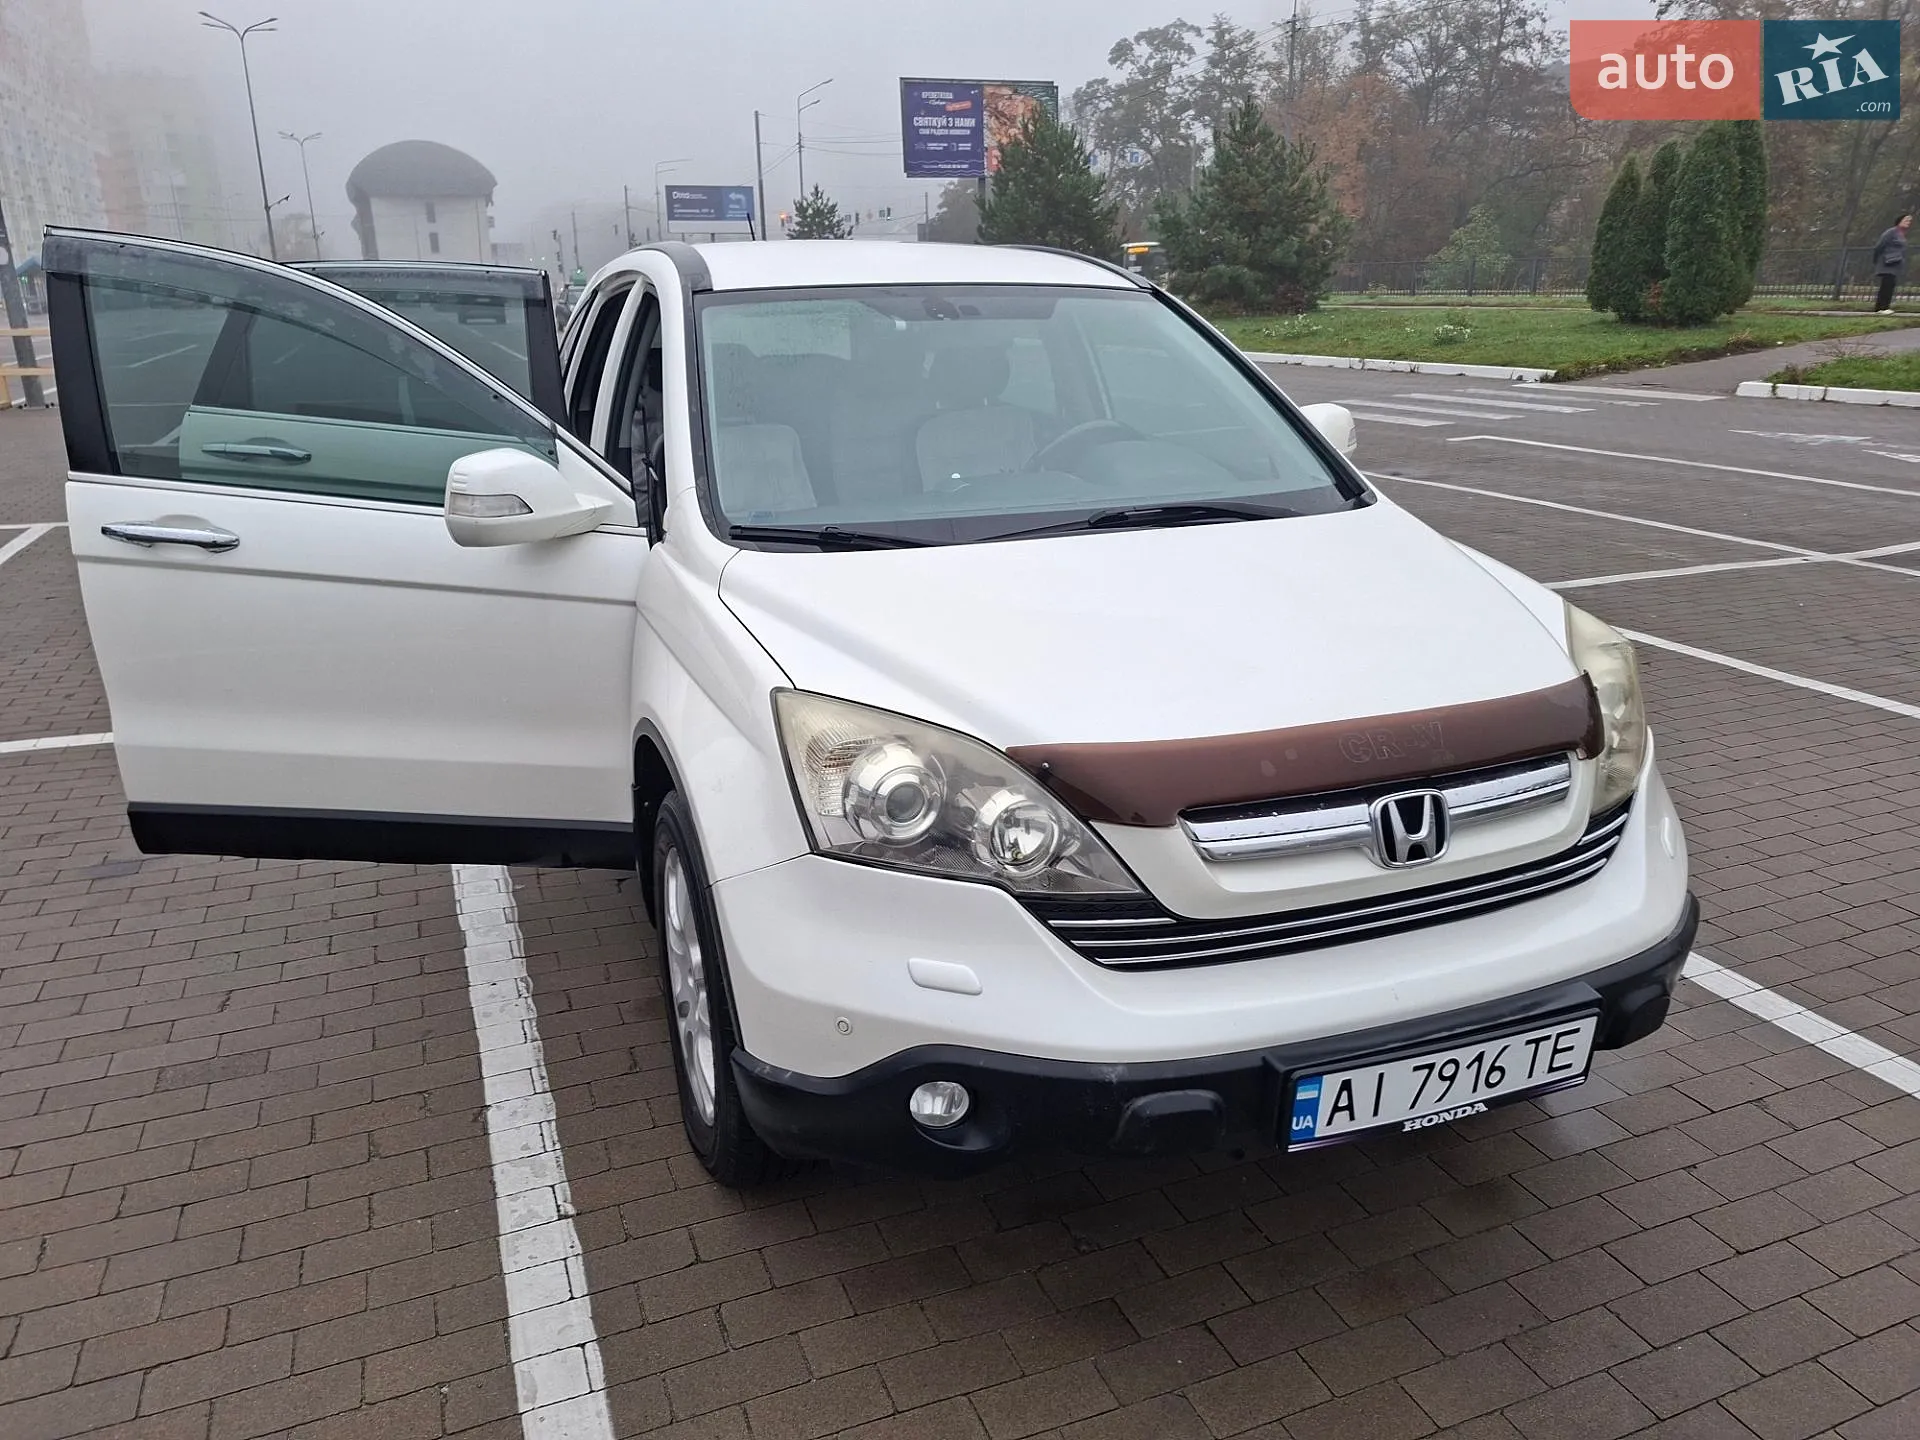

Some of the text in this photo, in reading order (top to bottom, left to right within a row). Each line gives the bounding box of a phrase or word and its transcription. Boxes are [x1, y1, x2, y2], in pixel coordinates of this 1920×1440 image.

[1325, 1027, 1581, 1127] AI 7916 TE
[1291, 1115, 1314, 1131] UA
[1402, 1102, 1489, 1132] HONDA
